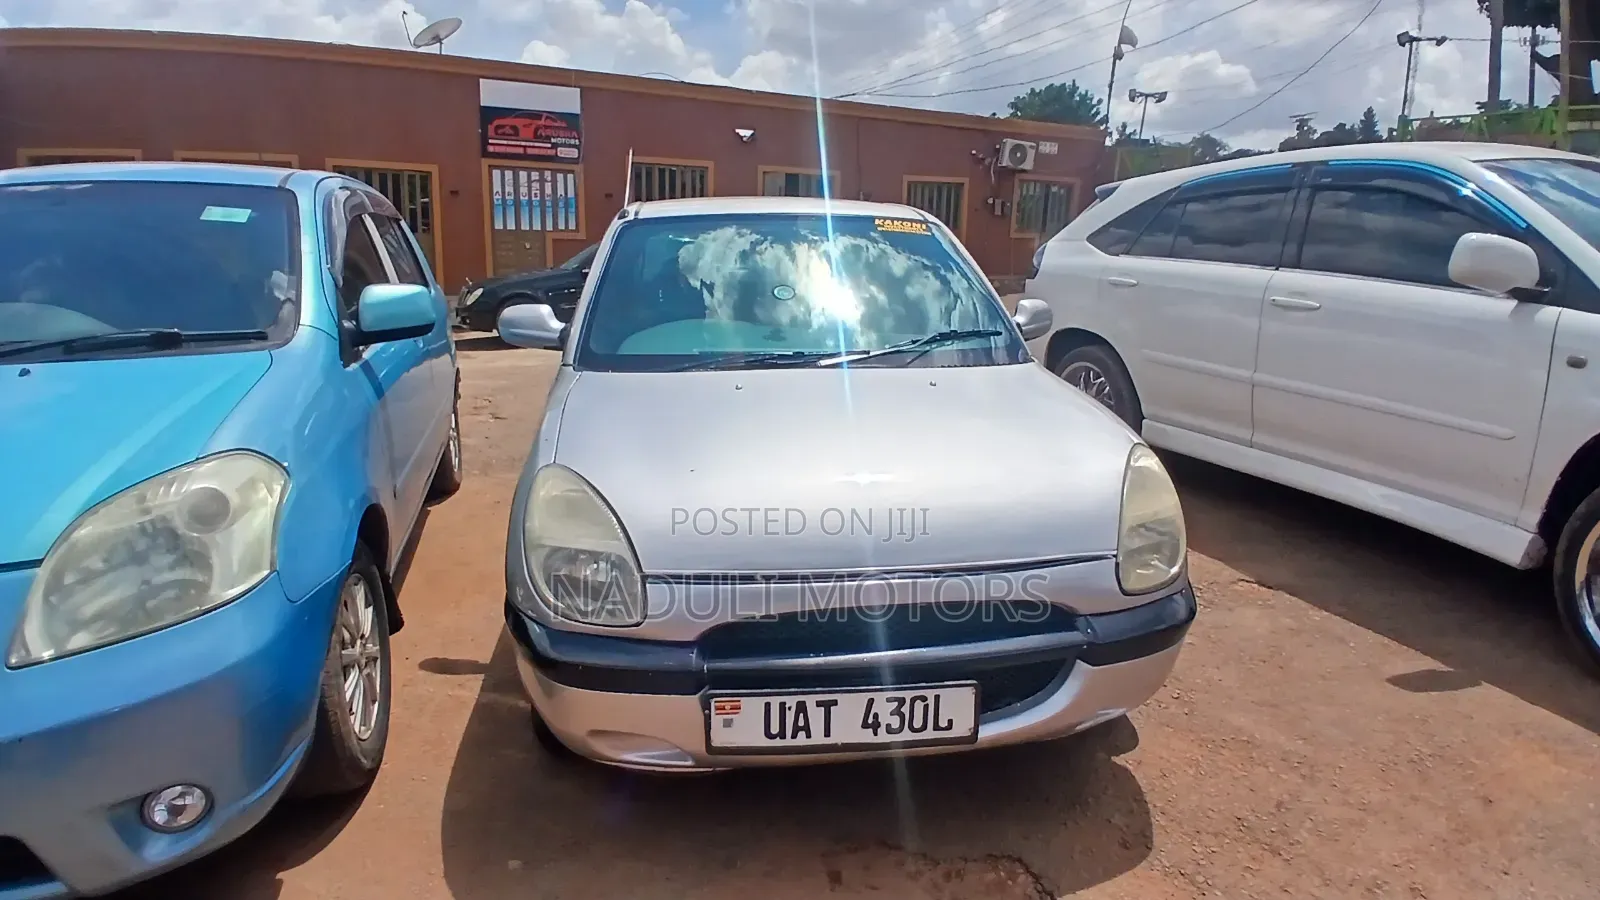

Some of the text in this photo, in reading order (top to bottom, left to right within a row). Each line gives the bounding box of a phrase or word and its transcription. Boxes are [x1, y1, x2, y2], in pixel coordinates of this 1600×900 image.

[551, 137, 580, 145] MOTORS
[763, 694, 954, 741] UAT 430L
